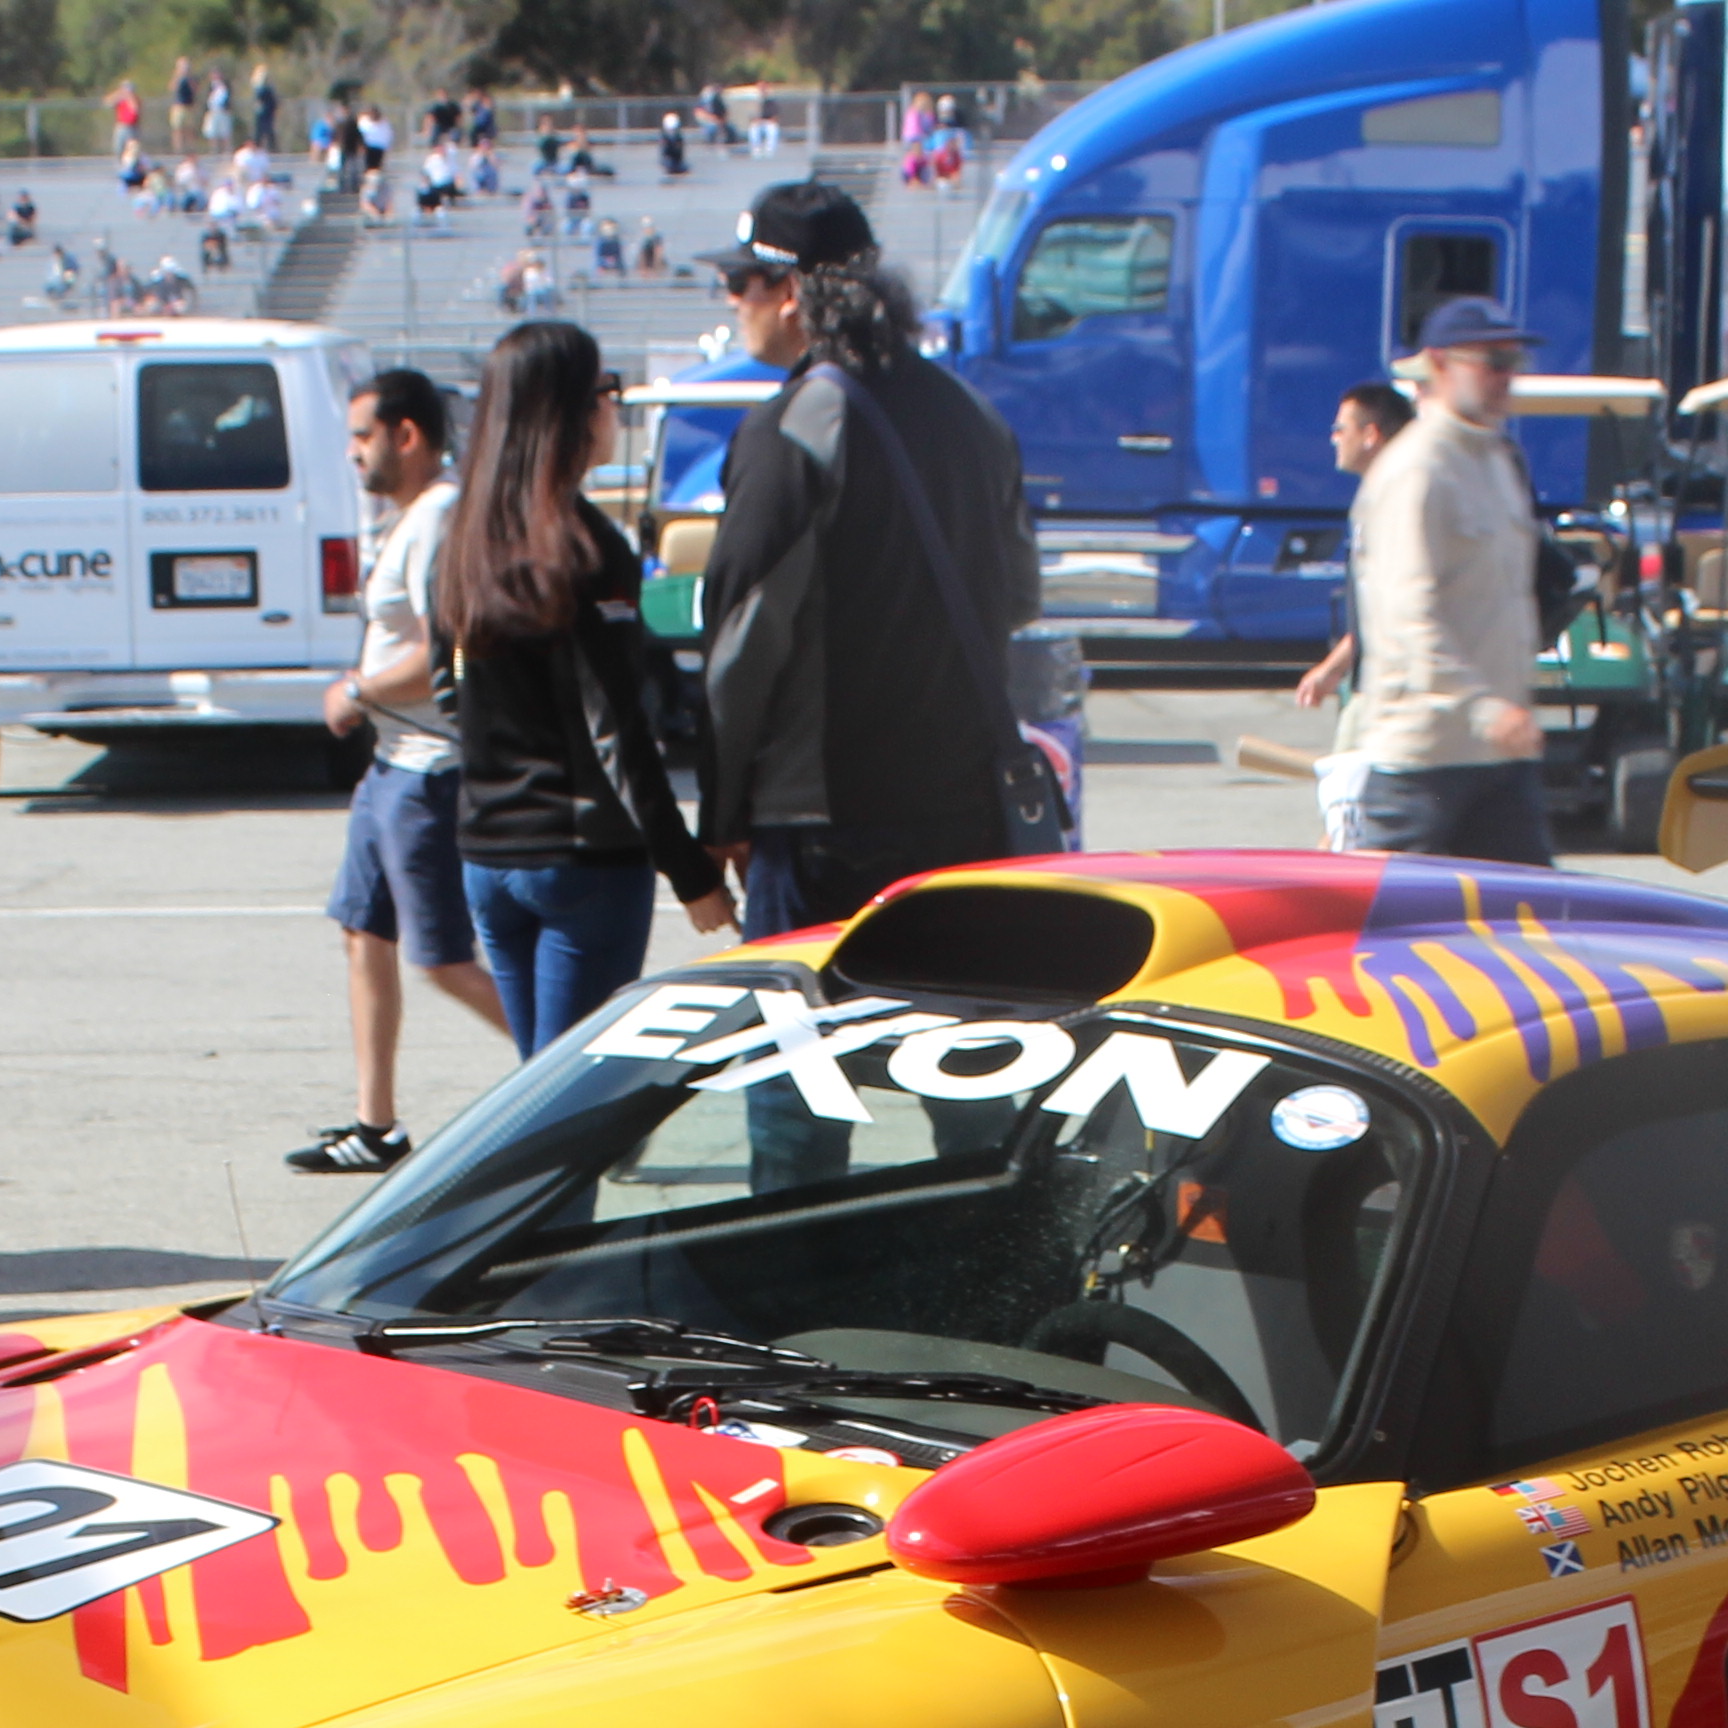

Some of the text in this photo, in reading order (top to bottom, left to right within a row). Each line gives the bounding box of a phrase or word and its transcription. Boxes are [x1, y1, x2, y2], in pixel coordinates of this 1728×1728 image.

[582, 983, 1273, 1140] EXXON
[1564, 1450, 1677, 1492] Jochen
[1597, 1487, 1677, 1528] Andy
[1615, 1532, 1692, 1574] Allan
